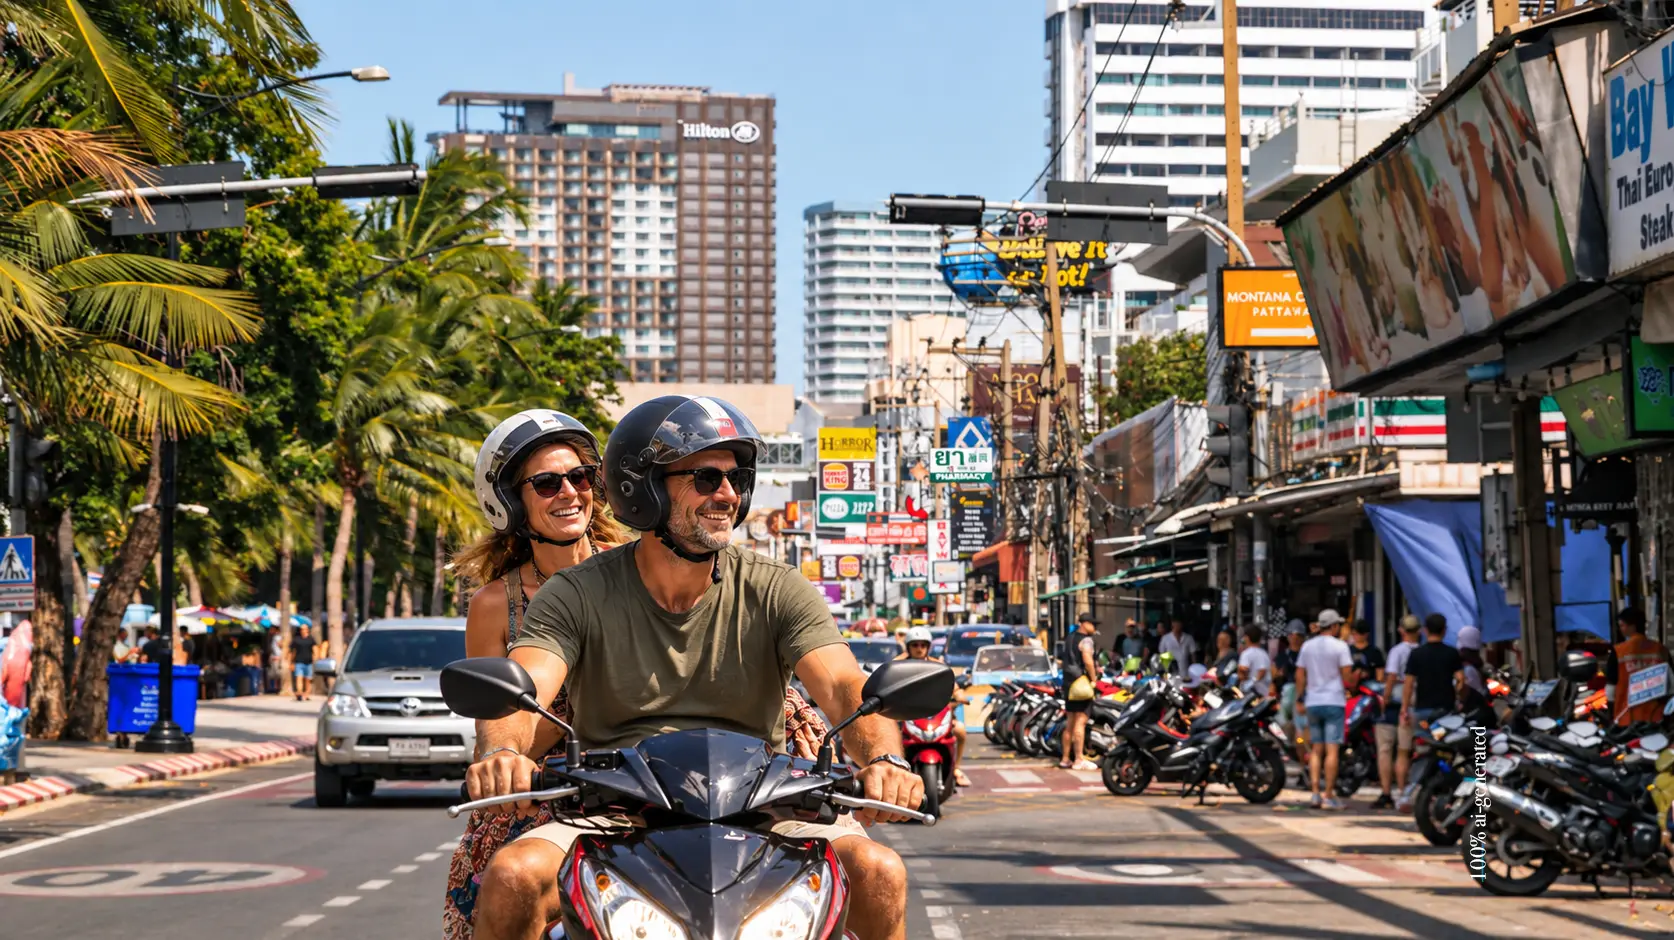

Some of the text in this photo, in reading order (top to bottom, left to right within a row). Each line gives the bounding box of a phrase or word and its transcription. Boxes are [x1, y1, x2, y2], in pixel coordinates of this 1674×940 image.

[1610, 75, 1655, 164] Bay
[683, 122, 731, 138] Hilton
[1617, 167, 1642, 210] Thai
[1640, 203, 1674, 250] Steak
[1084, 240, 1107, 259] It
[1227, 291, 1291, 302] MONTANA
[820, 437, 873, 452] HORROR
[935, 450, 965, 466] ยา
[825, 476, 847, 484] KING
[935, 473, 986, 481] PHARMACY
